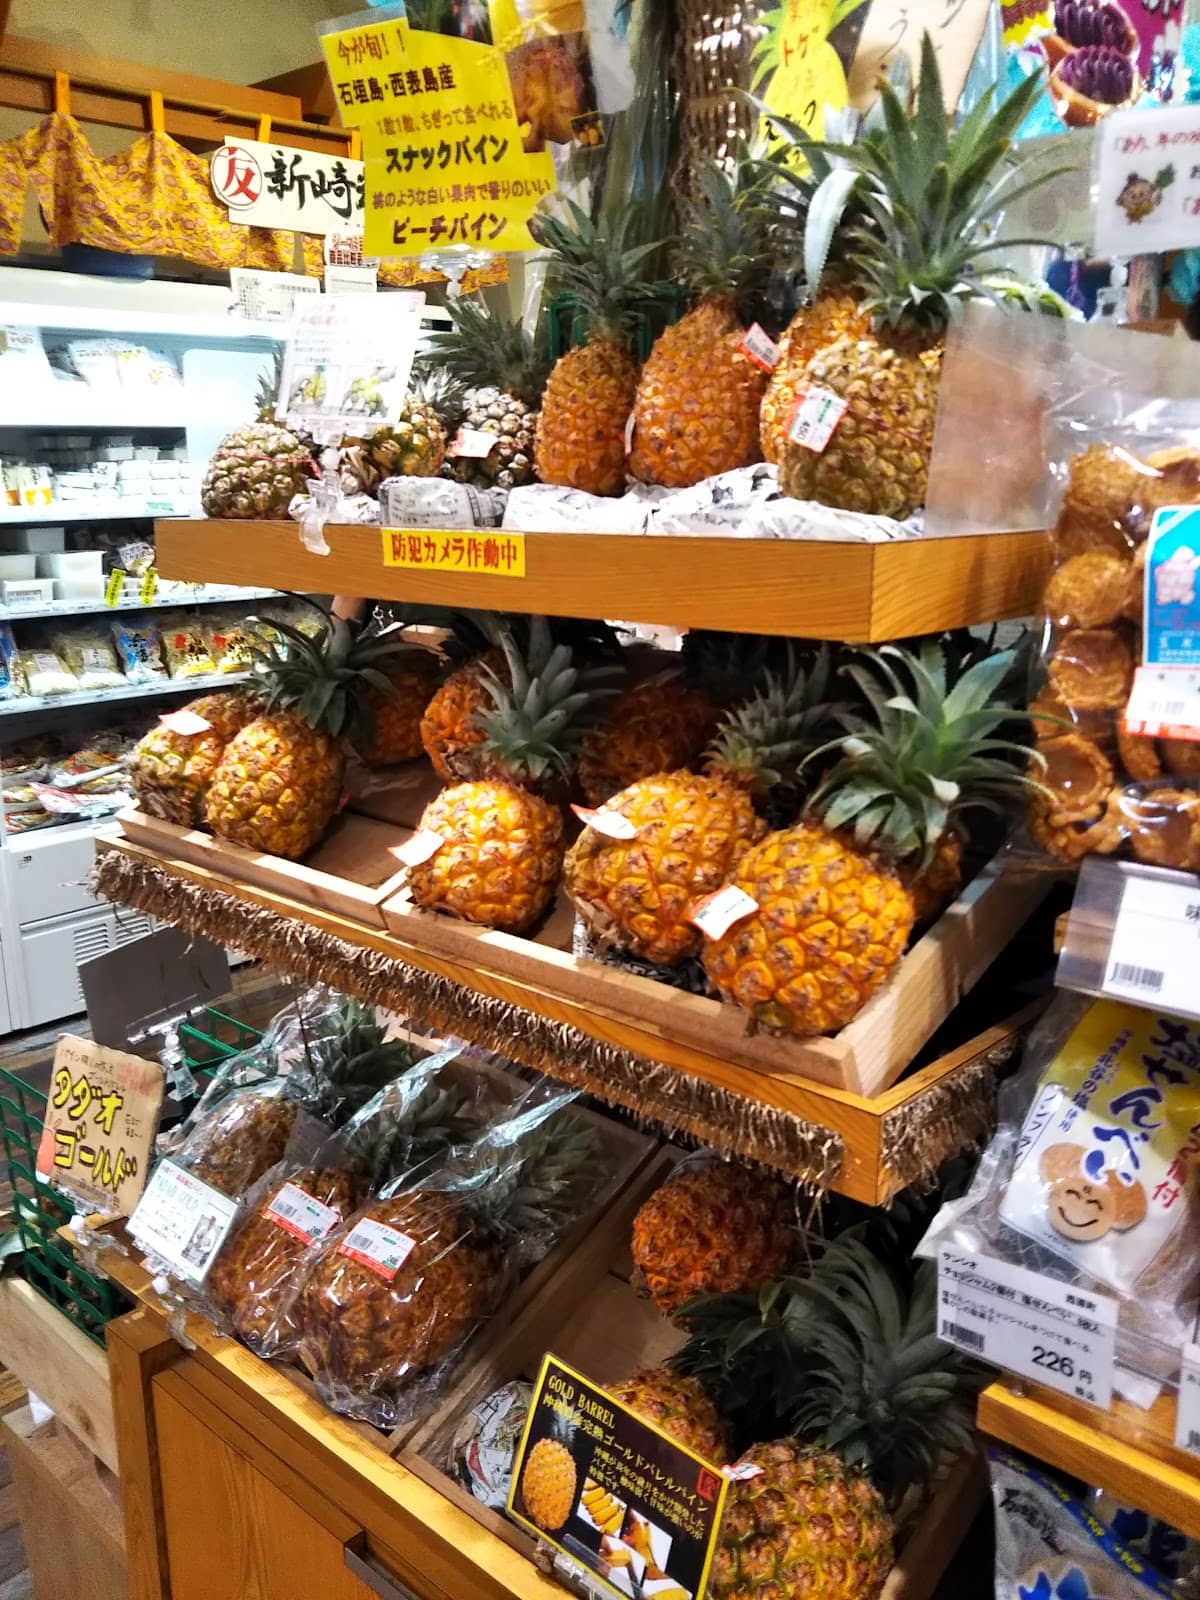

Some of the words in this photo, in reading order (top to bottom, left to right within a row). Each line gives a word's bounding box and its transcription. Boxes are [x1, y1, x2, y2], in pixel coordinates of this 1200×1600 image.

[337, 62, 456, 106] 石垣島・西表島産
[371, 177, 551, 211] 桃のような白い果肉で香りのいい
[390, 533, 518, 571] 防犯カメラ作動中
[54, 1123, 139, 1194] ゴールド
[1031, 1345, 1075, 1378] 226
[1078, 1369, 1093, 1385] 円
[548, 1374, 575, 1400] GOLD
[578, 1395, 616, 1430] BARREL
